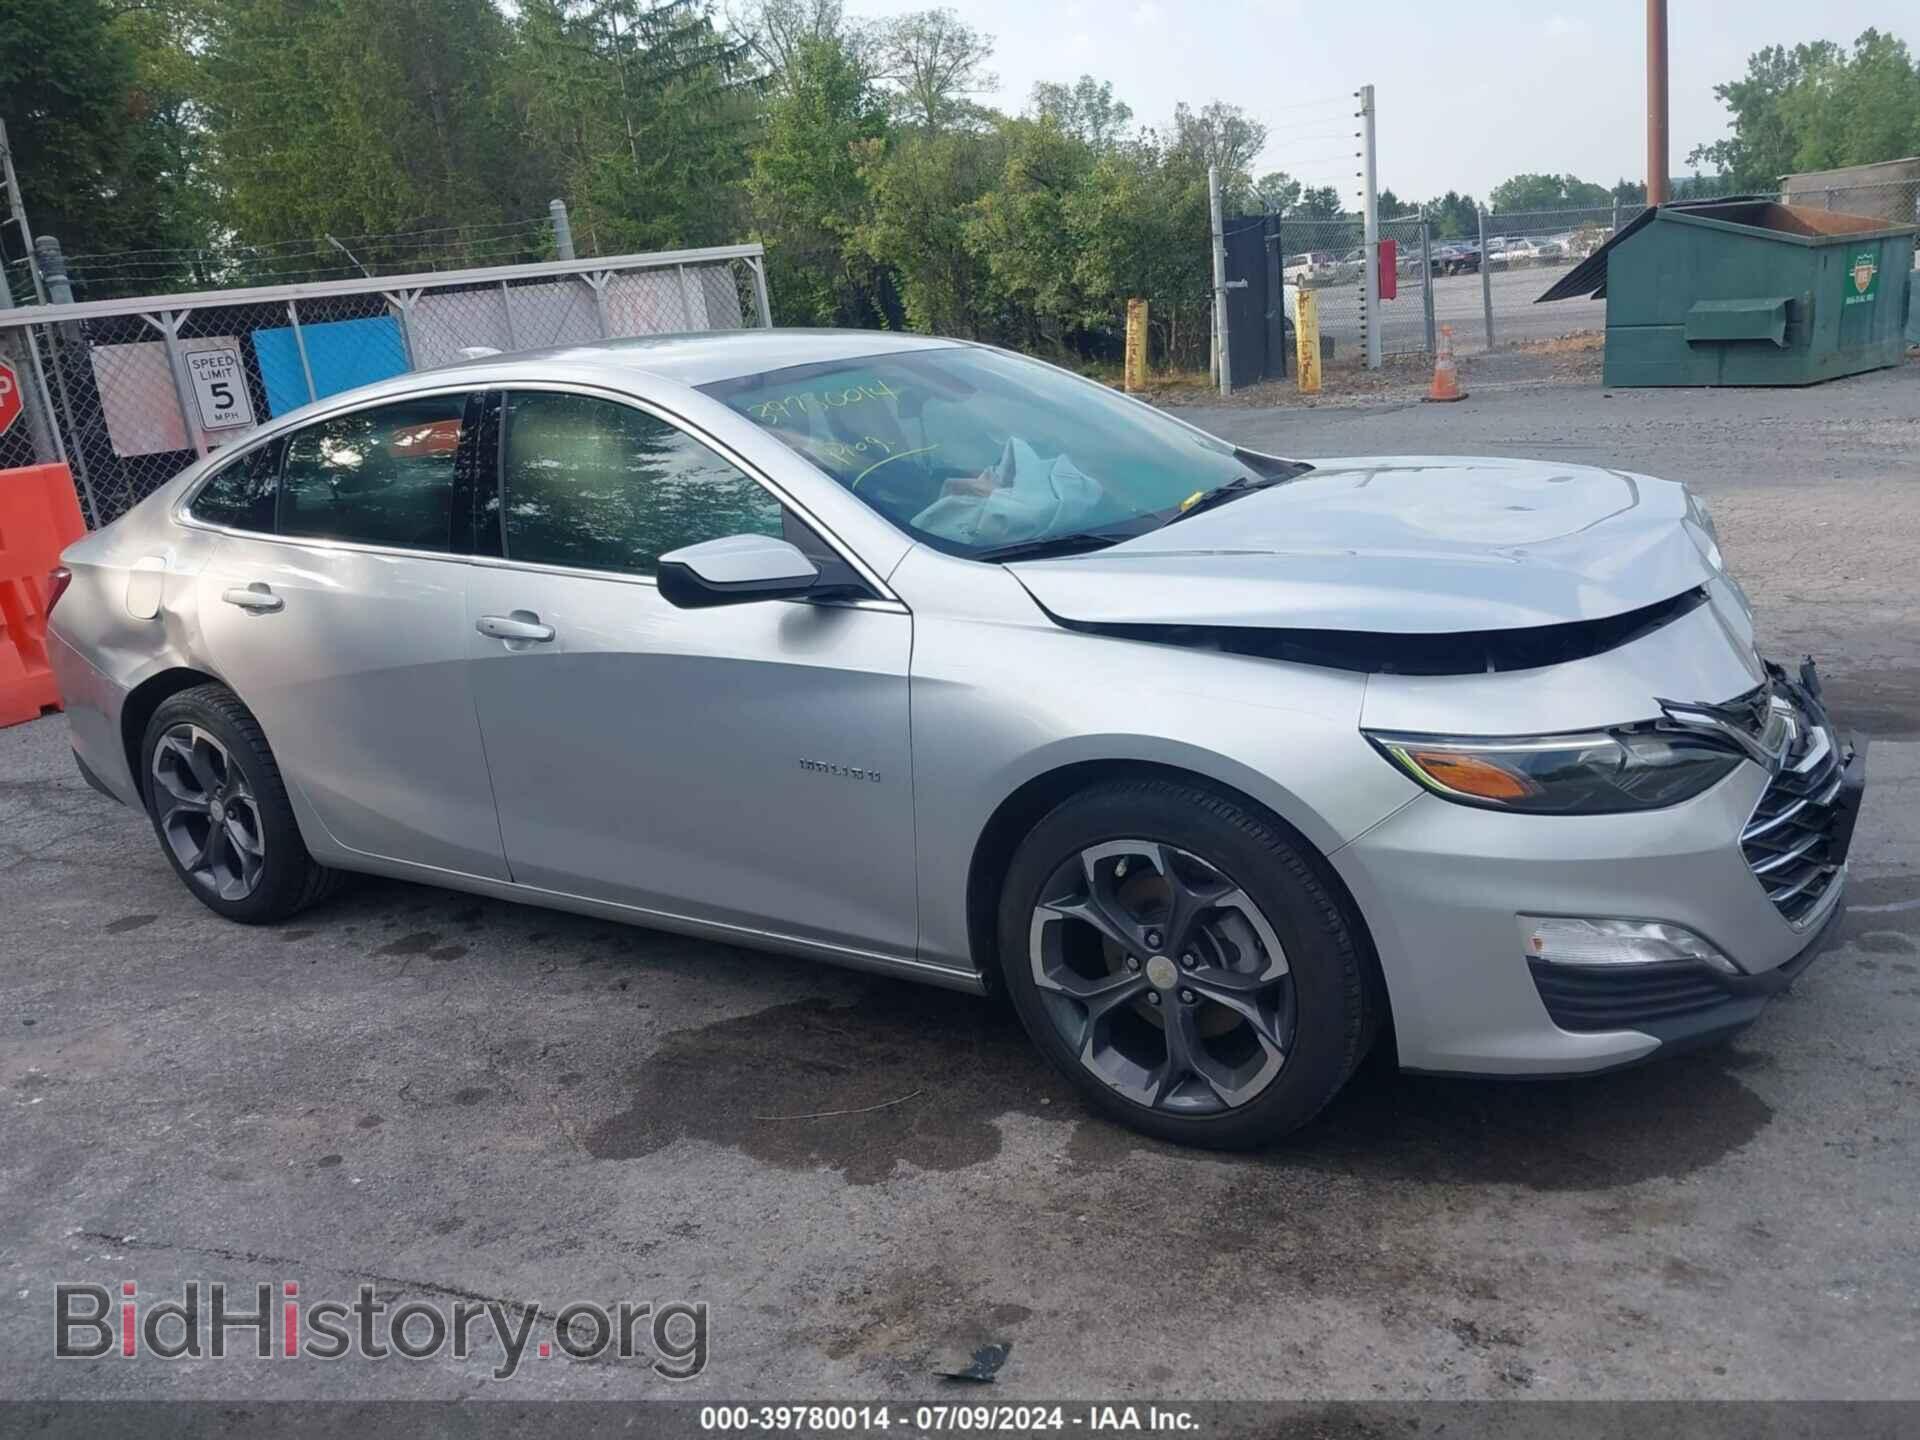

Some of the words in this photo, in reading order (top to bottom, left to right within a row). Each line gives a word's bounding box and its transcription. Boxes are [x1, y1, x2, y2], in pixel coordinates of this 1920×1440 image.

[192, 355, 235, 370] SPEED
[200, 368, 233, 381] LIMIT
[210, 382, 235, 410] 5
[214, 411, 240, 421] MPH
